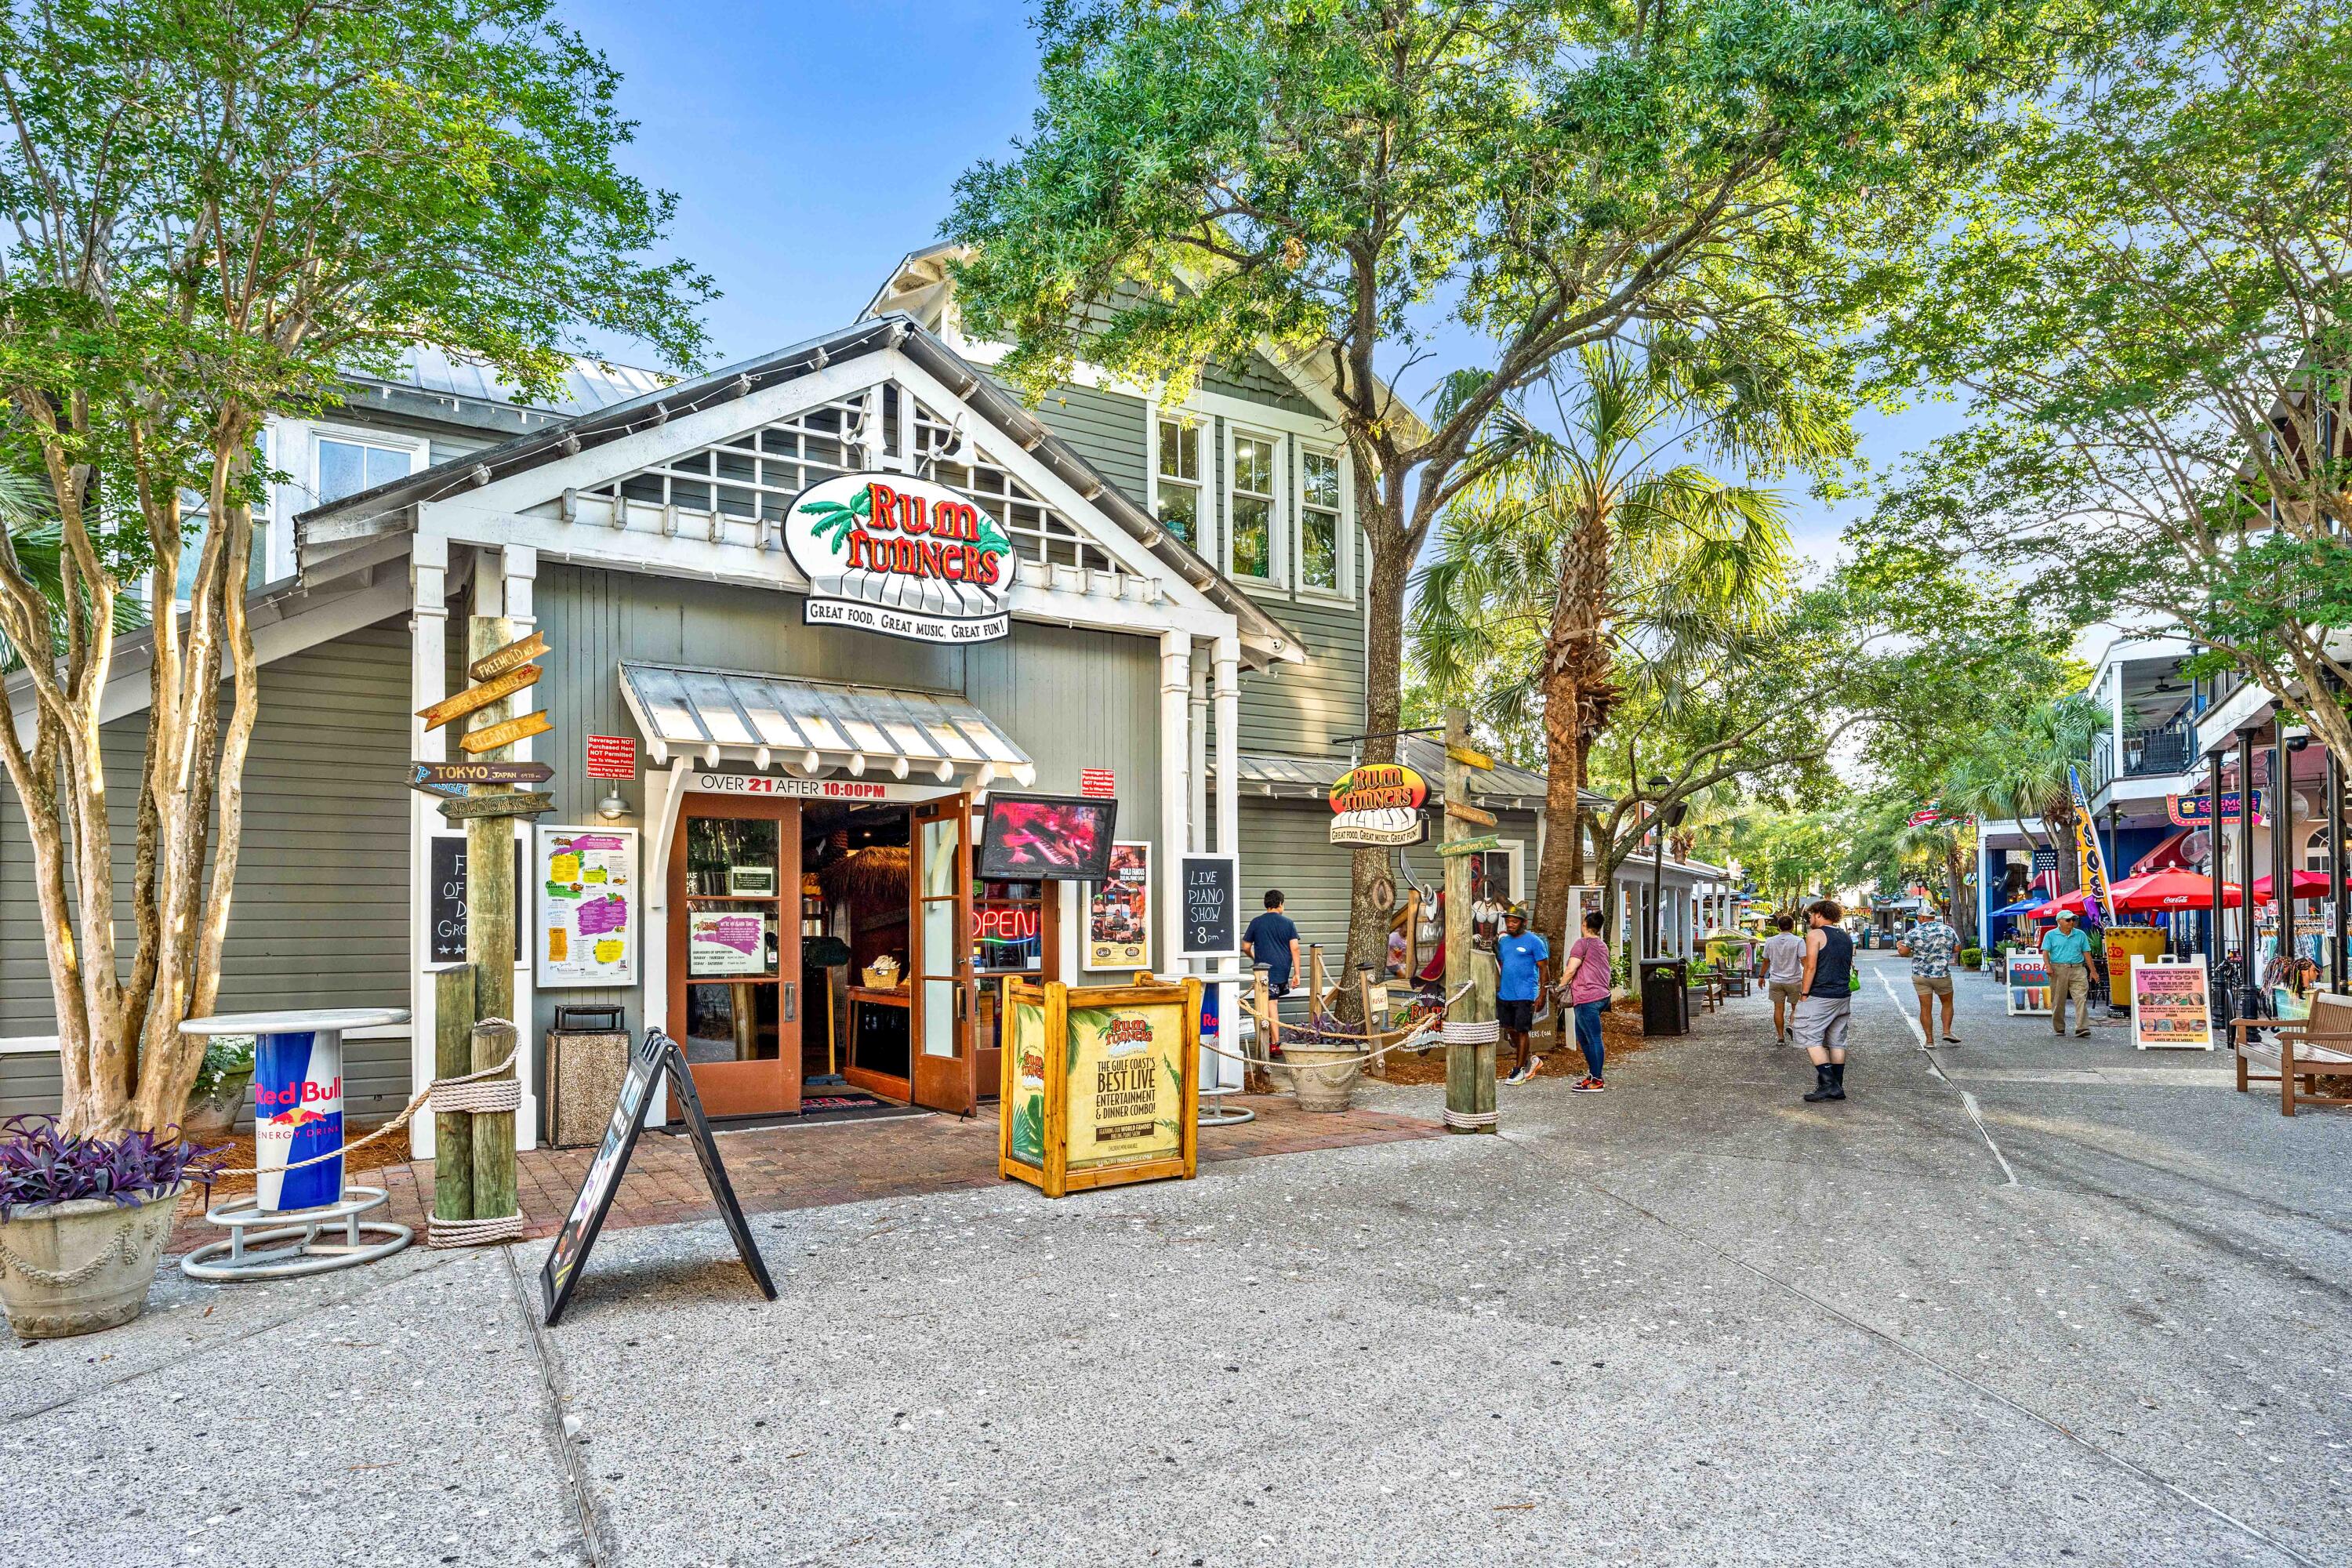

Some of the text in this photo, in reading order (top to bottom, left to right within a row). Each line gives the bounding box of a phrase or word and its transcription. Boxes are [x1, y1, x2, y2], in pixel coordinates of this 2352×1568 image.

[866, 481, 982, 542] Rum
[435, 766, 488, 779] TOKYO
[701, 775, 886, 798] OVER 21 AFTER 10:00PM
[450, 796, 541, 815] NEW YORK CITY
[1190, 870, 1218, 885] LIVE
[1188, 887, 1225, 904] PIANO
[2163, 895, 2189, 904] Coca-Cola
[1190, 906, 1221, 923] SHOW
[2014, 963, 2048, 972] BOBA
[2020, 973, 2045, 982] TEA
[1097, 1057, 1156, 1073] THE GULF COAST'S
[1098, 1068, 1156, 1094] BEST LIVE
[255, 1076, 342, 1105] Red Bull
[1096, 1089, 1156, 1108] ENTERTAINMENT
[1095, 1102, 1156, 1120] & DINNER COMBO!
[257, 1125, 339, 1140] ENERGY DRINK
